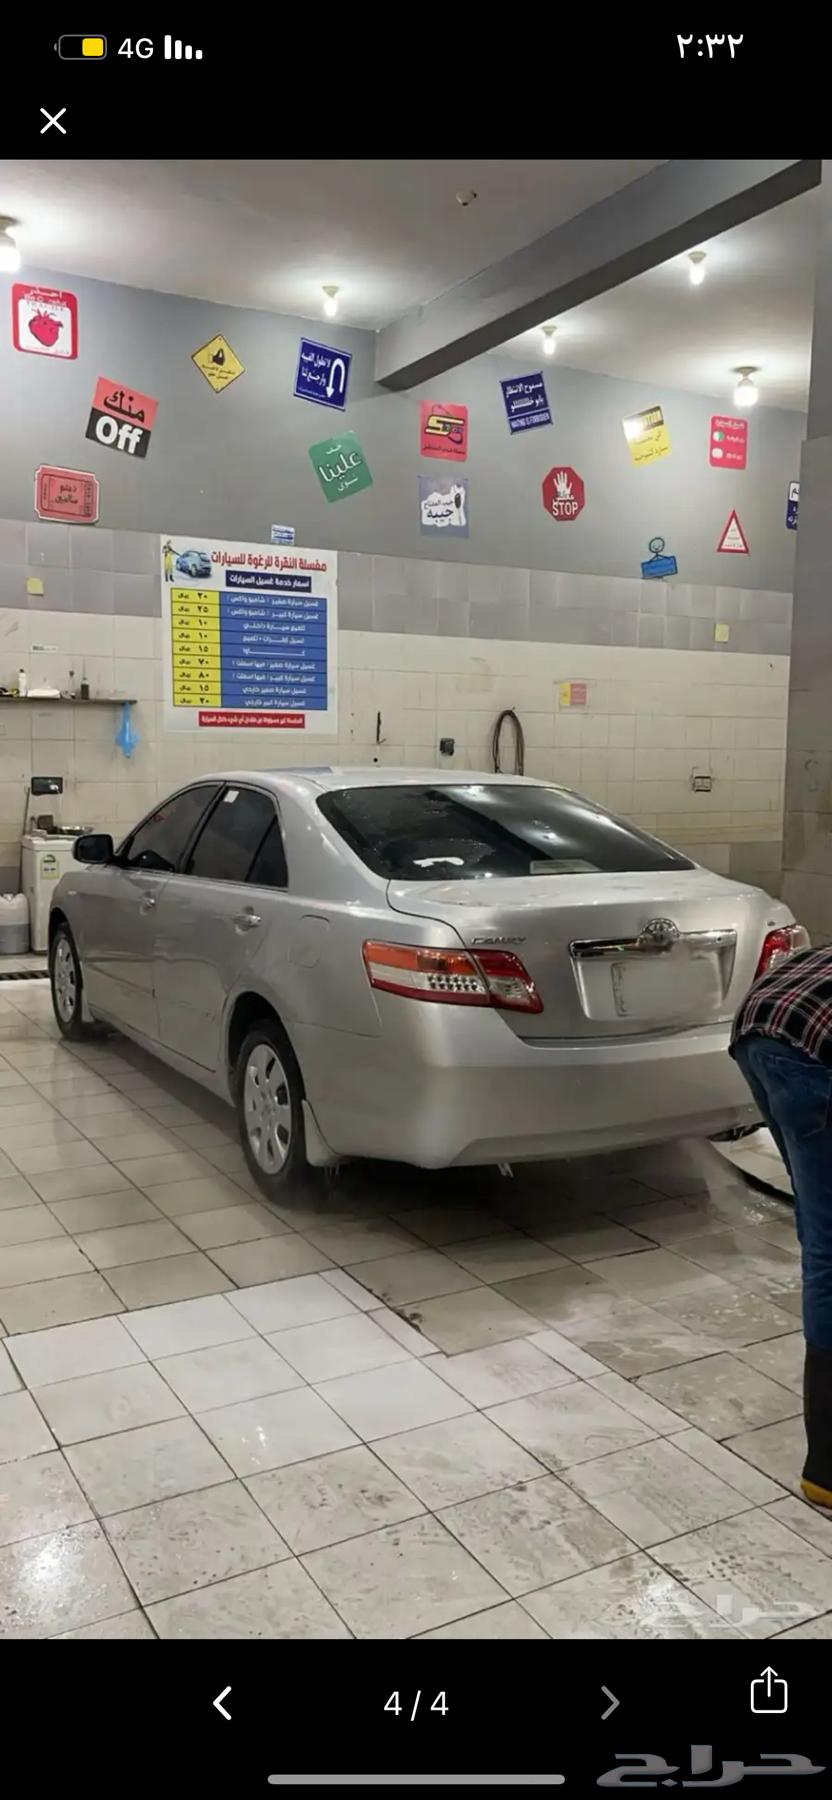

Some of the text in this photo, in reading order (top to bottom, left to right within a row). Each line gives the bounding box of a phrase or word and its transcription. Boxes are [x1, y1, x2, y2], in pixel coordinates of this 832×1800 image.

[118, 38, 153, 58] 4G
[677, 34, 743, 58] ٢:٣٢
[103, 390, 145, 423] منك
[96, 415, 143, 454] Off
[319, 452, 361, 482] علينا
[552, 501, 578, 516] STOP
[211, 551, 246, 566] للسيارات
[275, 556, 298, 571] النقرة
[299, 558, 327, 572] مغسلة
[229, 574, 255, 584] السيارات
[256, 576, 274, 586] غسيل
[276, 577, 292, 586] خدمة
[384, 1692, 402, 1715] 4
[431, 1692, 448, 1715] 4
